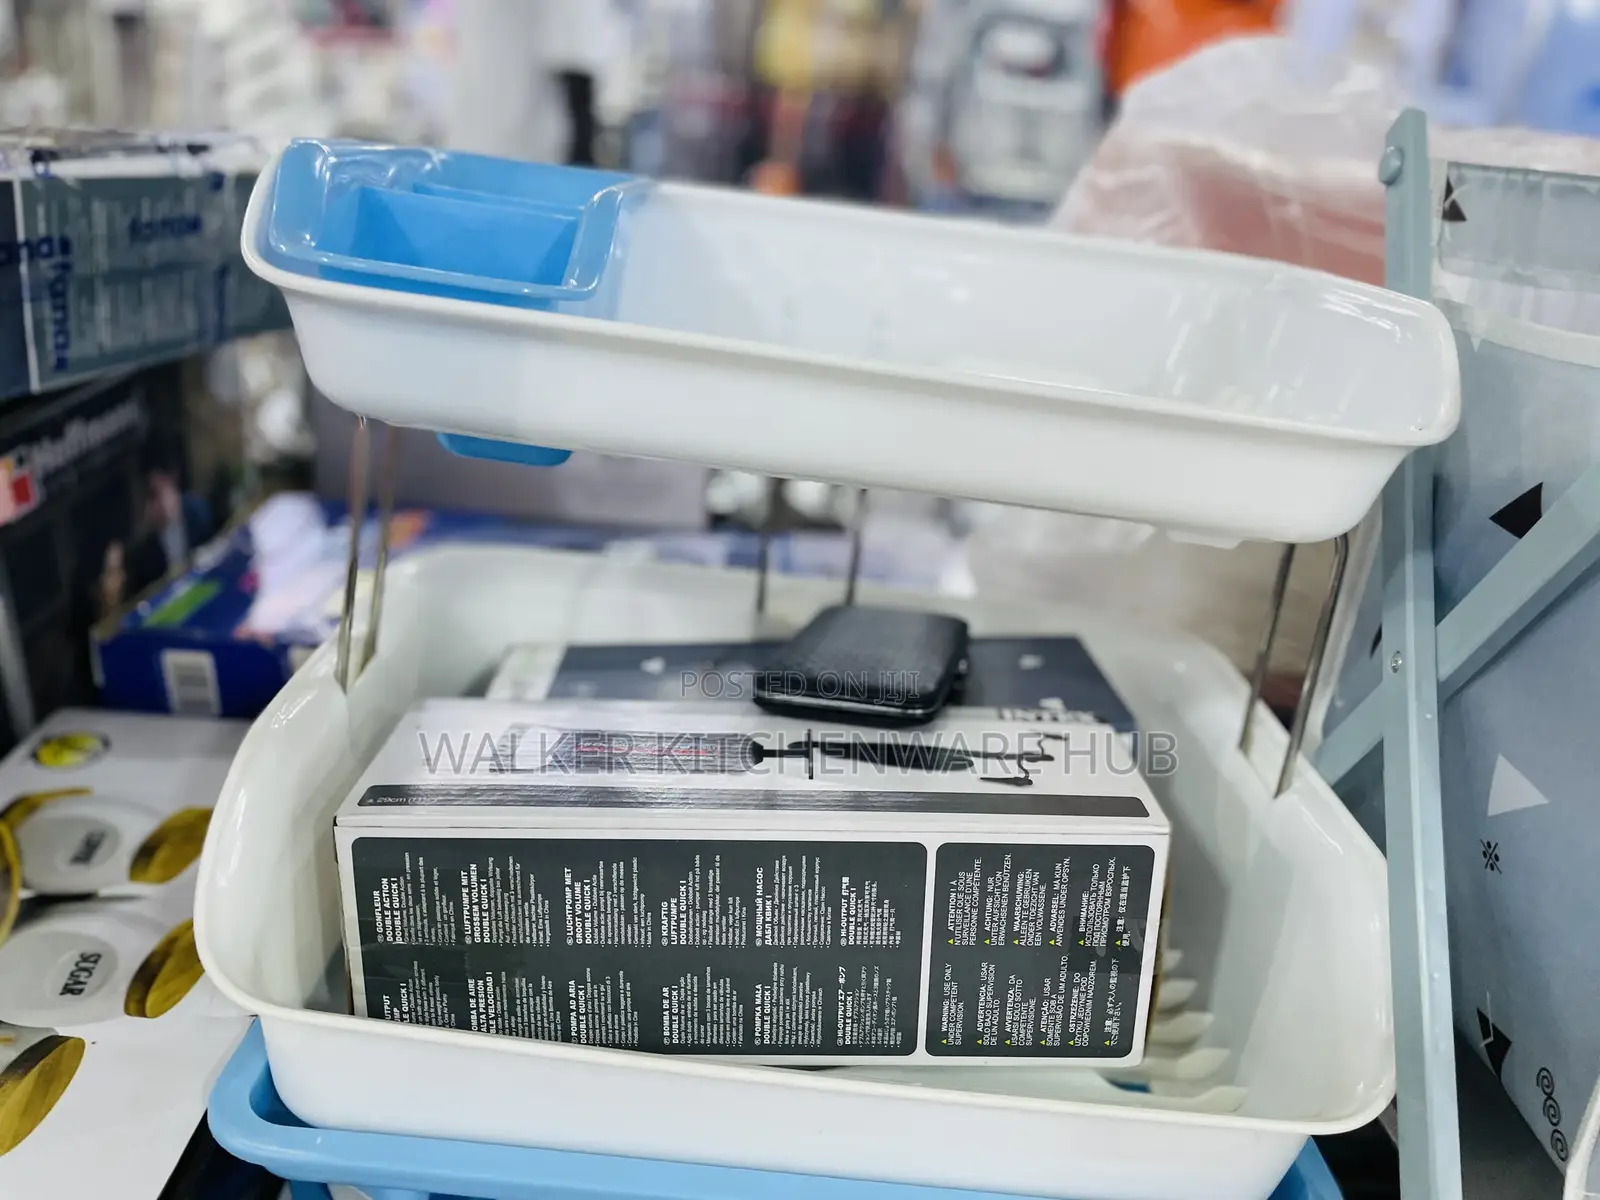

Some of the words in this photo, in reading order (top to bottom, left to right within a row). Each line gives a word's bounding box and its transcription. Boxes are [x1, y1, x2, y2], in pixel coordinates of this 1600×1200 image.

[470, 864, 479, 903] VOLUMEN
[958, 872, 966, 891] SOUS
[965, 872, 973, 893] D'UNE
[972, 857, 982, 907] COMPÉTENTE.
[995, 871, 1003, 887] VON
[1002, 853, 1011, 892] BENÜTZEN.
[1032, 872, 1040, 886] VAN
[1053, 879, 1061, 890] MÅ
[1062, 857, 1070, 883] OPSYN.
[1090, 864, 1099, 891] ТОЛЬКО
[1105, 857, 1115, 897] ВЗРОСЛЫХ.
[381, 878, 391, 908] ACTION
[391, 883, 400, 909] QUICK
[480, 884, 488, 910] QUICK
[574, 882, 582, 915] VOLUME
[1013, 872, 1024, 932] WAARSCHUWING:
[1022, 869, 1032, 909] GEBRUIKEN
[1029, 887, 1038, 921] TOEZICHT
[1059, 884, 1068, 908] UNDER
[373, 891, 383, 933] GONFLEUR
[462, 888, 471, 934] LUFTPUMPE
[565, 887, 573, 936] LUCHTPOMP
[755, 898, 763, 937] МОЩНЫЙ
[948, 893, 956, 931] ATTENTION
[984, 895, 993, 931] ACHTUNG:
[993, 888, 1001, 922] AUFSICHT
[998, 894, 1008, 946] ERWACHSENEN
[1022, 910, 1029, 919] TE
[1036, 883, 1046, 931] VOLWASSENE.
[1050, 893, 1059, 932] ADVARSEL:
[1079, 891, 1089, 932] ВНИМАНИЕ:
[1085, 893, 1097, 947] ИСПОЛЬЗОВАТЬ
[1094, 881, 1105, 931] ПОСТОЯННЫМ
[384, 910, 393, 941] DOUBLE
[393, 910, 402, 942] DOUBLE
[472, 905, 481, 943] GROSSEM
[482, 912, 490, 943] DOUBLE
[575, 917, 583, 944] GROOT
[954, 909, 963, 946] N'UTILISER
[962, 895, 972, 946] SURVEILLANCE
[969, 908, 978, 945] PERSONNE
[991, 923, 999, 946] UNTER
[1020, 921, 1028, 946] ALLEEN
[1027, 922, 1035, 946] ONDER
[1056, 910, 1065, 947] ANVENDES
[1100, 898, 1111, 947] ПРИСМОТРОМ
[1093, 932, 1101, 947] ПОД
[59, 952, 103, 996] SUGAR
[944, 963, 952, 981] ONLY
[980, 962, 988, 981] USAR
[1009, 975, 1016, 984] DA
[1060, 955, 1068, 982] ADULTO.
[1073, 973, 1081, 983] DO
[1087, 960, 1097, 999] NADZOREM.
[477, 980, 486, 1013] PRESIÓN
[662, 987, 669, 998] AR
[986, 964, 995, 1009] SUPERVISION
[1015, 979, 1023, 1002] SOTTO
[1043, 978, 1051, 996] USAR
[1058, 983, 1065, 993] UM
[1080, 977, 1088, 991] POD
[383, 995, 391, 1019] UTPUT
[400, 988, 409, 1012] QUICK
[570, 1000, 577, 1010] AD
[578, 990, 586, 1014] QUICK
[663, 999, 669, 1009] DE
[949, 981, 958, 1022] COMPETENT
[977, 984, 987, 1032] ADVERTENCIA:
[992, 997, 1000, 1025] ADULTO.
[1005, 988, 1015, 1032] AVVERTENZA:
[1013, 1003, 1021, 1021] SOLO
[1049, 1000, 1057, 1014] SOB
[1057, 995, 1065, 1004] DE
[1069, 986, 1079, 1033] OSTRZEŻENIE:
[1078, 993, 1086, 1020] JEDYNIE
[470, 1010, 478, 1031] OMBA
[570, 1012, 578, 1036] POMPA
[579, 1015, 587, 1043] DOUBLE
[941, 999, 949, 1032] WARNING:
[955, 1000, 964, 1045] SUPERVISION.
[984, 1010, 992, 1027] BAJO
[991, 1026, 998, 1035] UN
[1018, 1002, 1028, 1046] COMPETENTE
[1026, 997, 1036, 1046] SUPERVISIONE.
[1040, 1000, 1049, 1033] ATENÇÃO:
[1046, 1015, 1055, 1046] SOMENTE
[1054, 1005, 1064, 1046] SUPERVISÃO
[1082, 1000, 1093, 1047] ODPOWIEDNIM
[983, 1028, 991, 1046] SOLO
[990, 1037, 997, 1046] DE
[1011, 1022, 1019, 1046] USARSI
[1075, 1021, 1083, 1046] UŻYTKU
